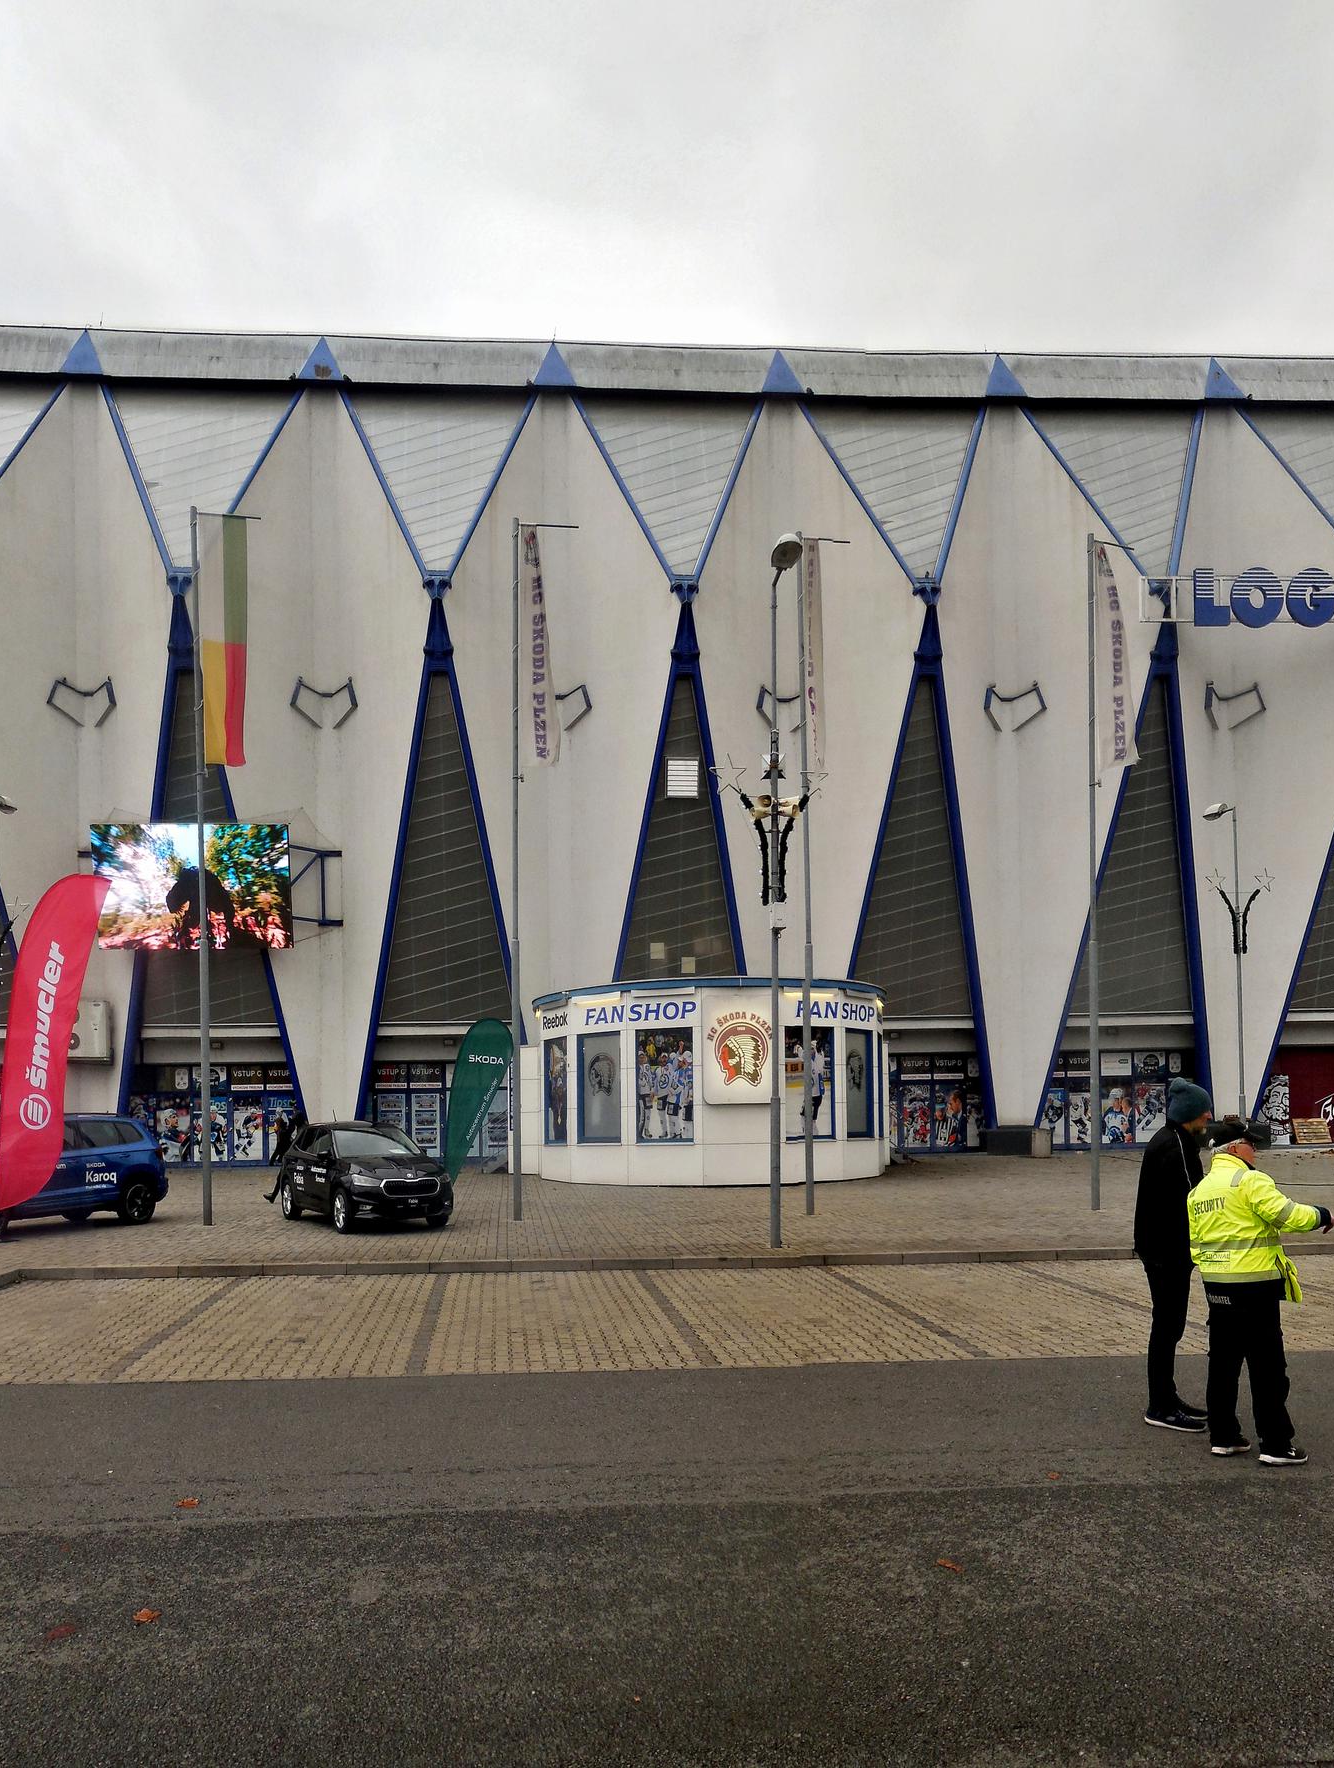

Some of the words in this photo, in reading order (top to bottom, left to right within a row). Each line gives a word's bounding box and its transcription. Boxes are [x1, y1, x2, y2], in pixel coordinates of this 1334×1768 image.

[542, 1011, 568, 1031] Reebok
[584, 1004, 625, 1026] FAN
[628, 1001, 697, 1022] SHOP
[795, 1000, 839, 1019] FAN
[841, 1002, 875, 1023] SHOP
[85, 1170, 117, 1184] Karoq
[293, 1172, 304, 1185] Fabia
[1193, 1196, 1226, 1216] SECURITY
